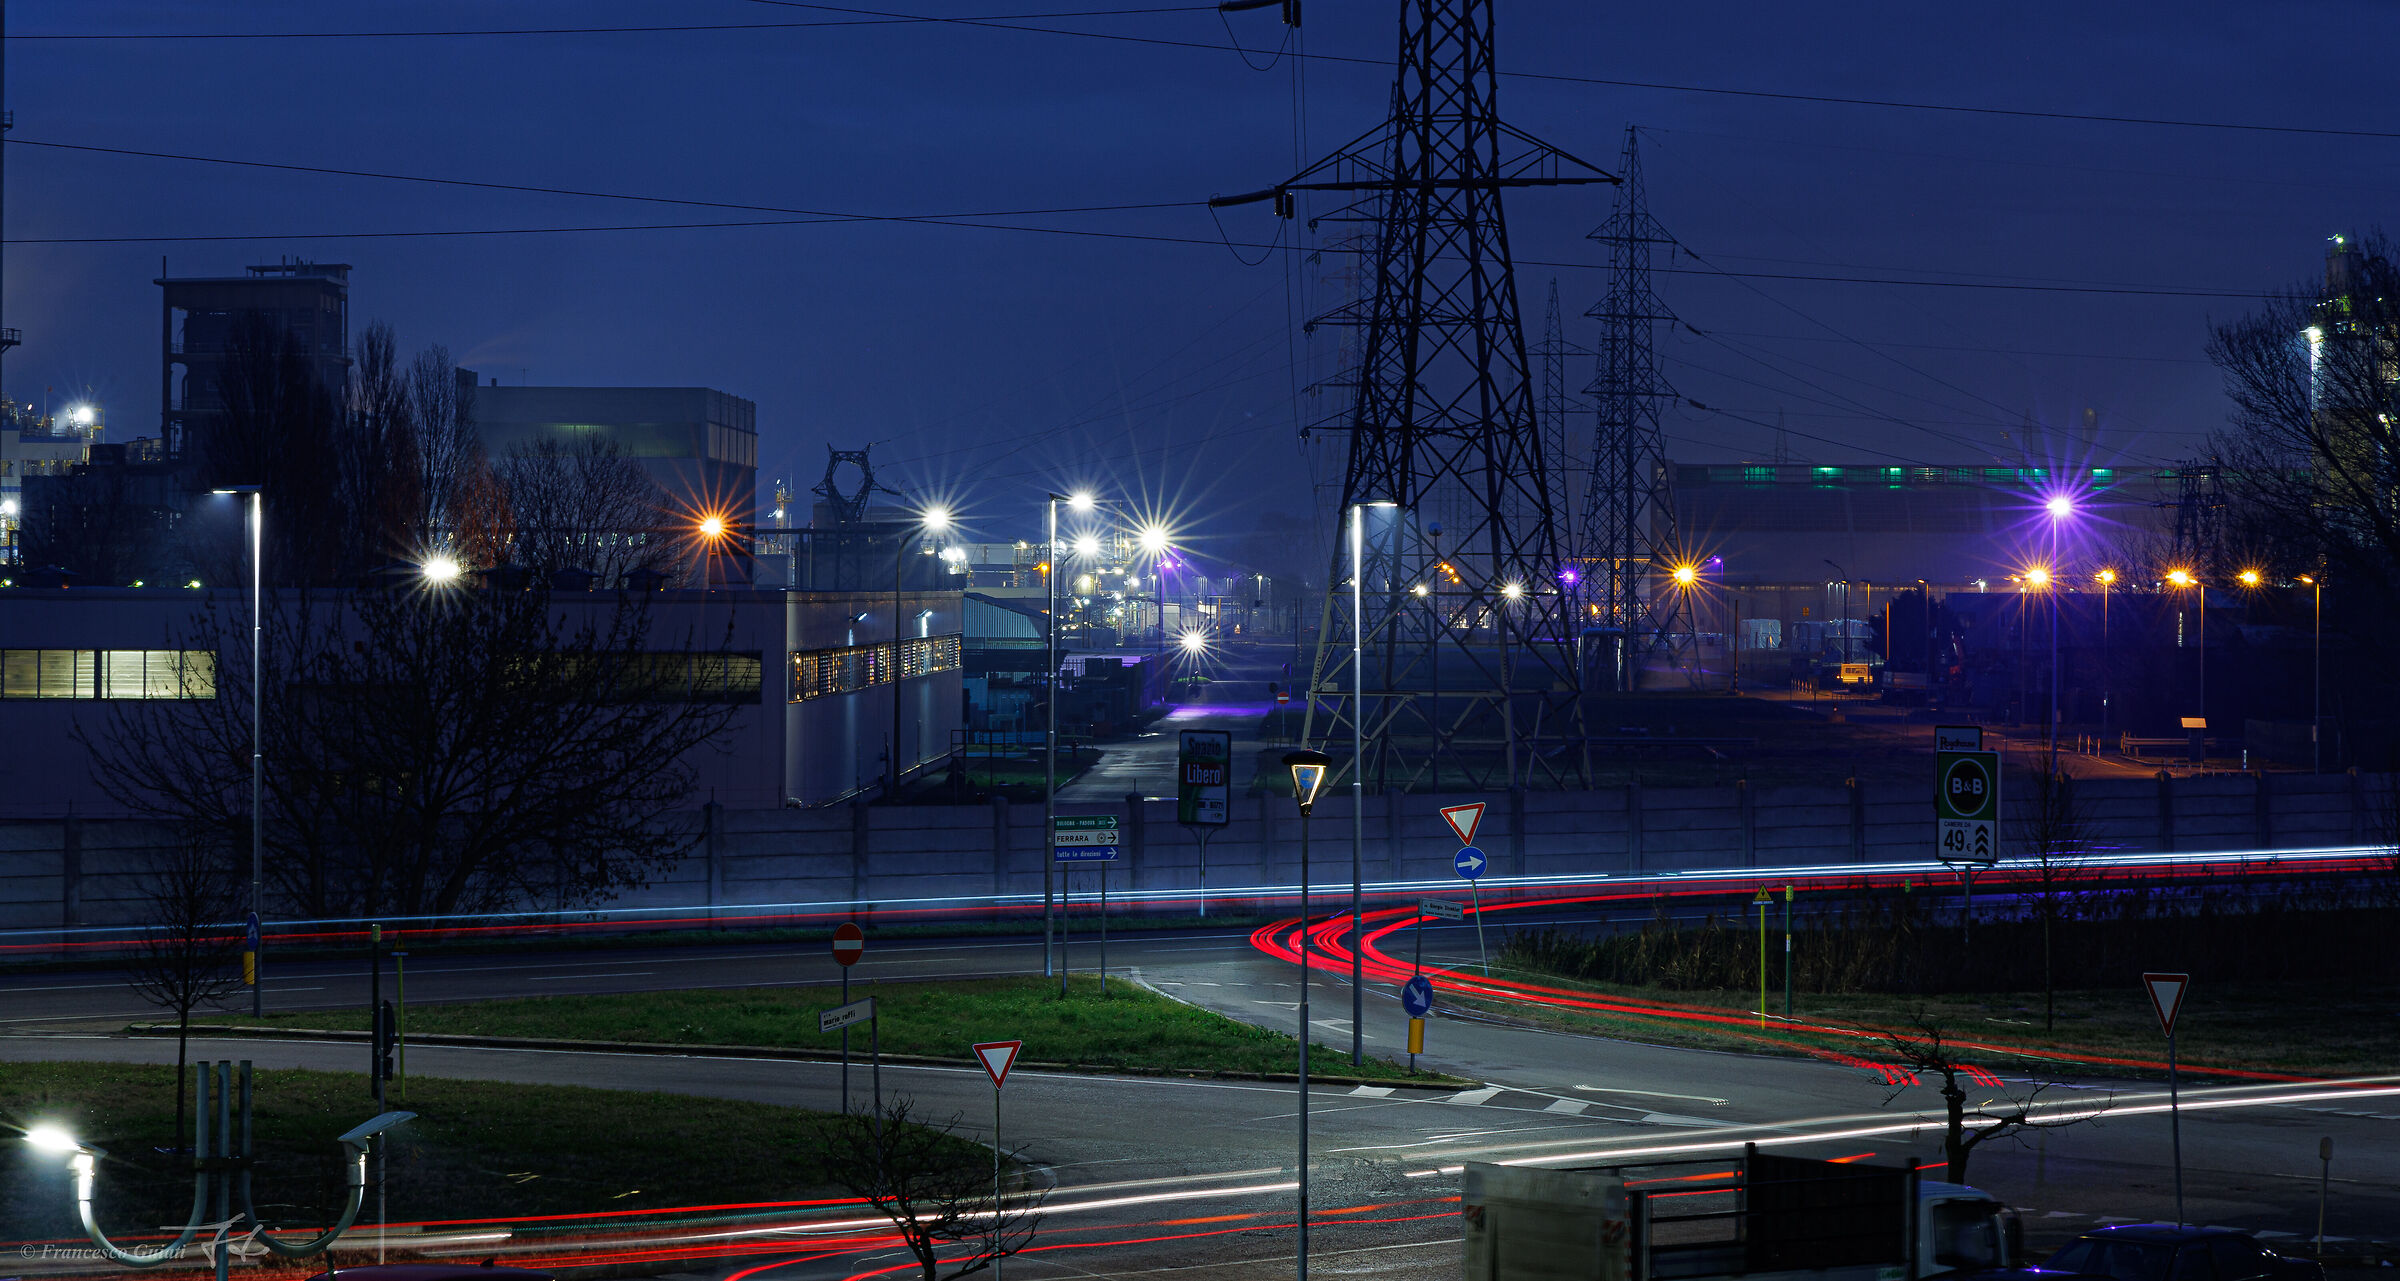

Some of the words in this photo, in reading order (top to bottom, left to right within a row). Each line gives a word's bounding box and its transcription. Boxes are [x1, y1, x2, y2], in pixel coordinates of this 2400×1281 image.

[1188, 737, 1221, 756] Spazio
[1187, 763, 1221, 784] Libero
[1952, 777, 1983, 795] B&B
